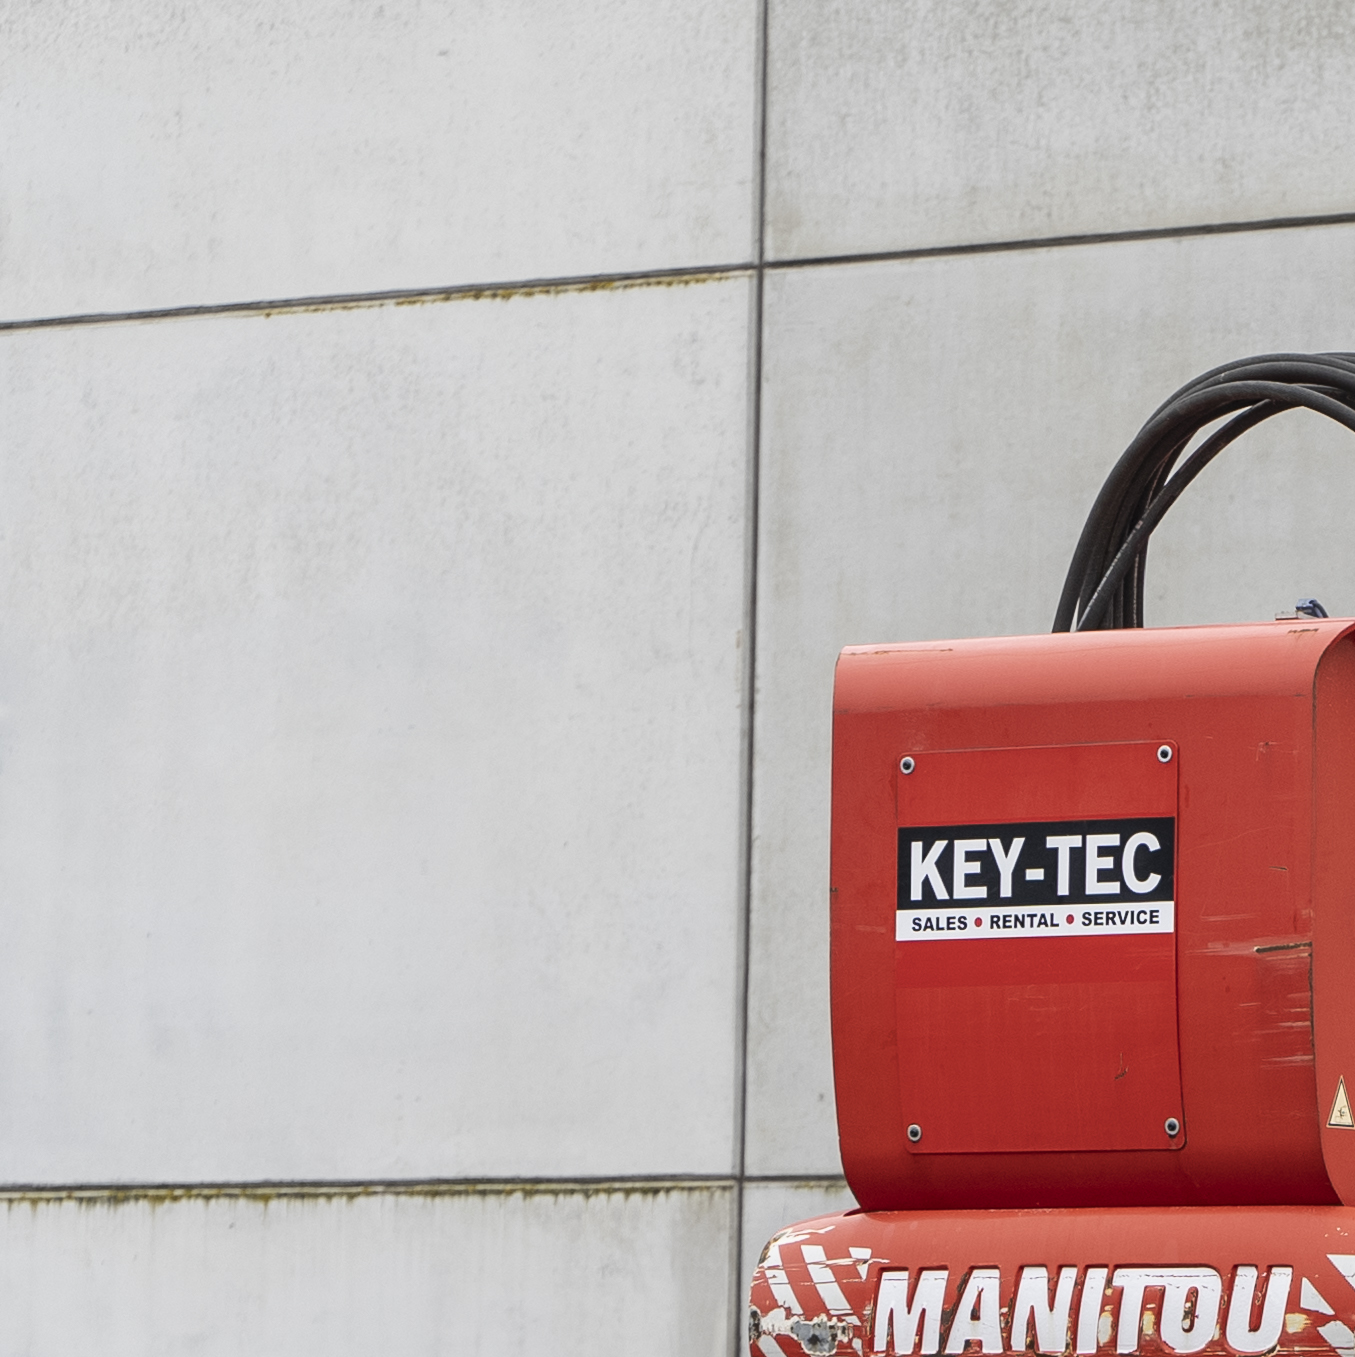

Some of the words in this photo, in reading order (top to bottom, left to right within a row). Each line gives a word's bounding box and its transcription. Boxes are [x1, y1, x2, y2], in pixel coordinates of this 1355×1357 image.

[910, 831, 1162, 901] KEY-TEC
[911, 915, 968, 932] SALES
[989, 912, 1060, 930] RENTAL
[1081, 909, 1161, 927] SERVICE
[873, 1266, 1294, 1355] MANITOU
